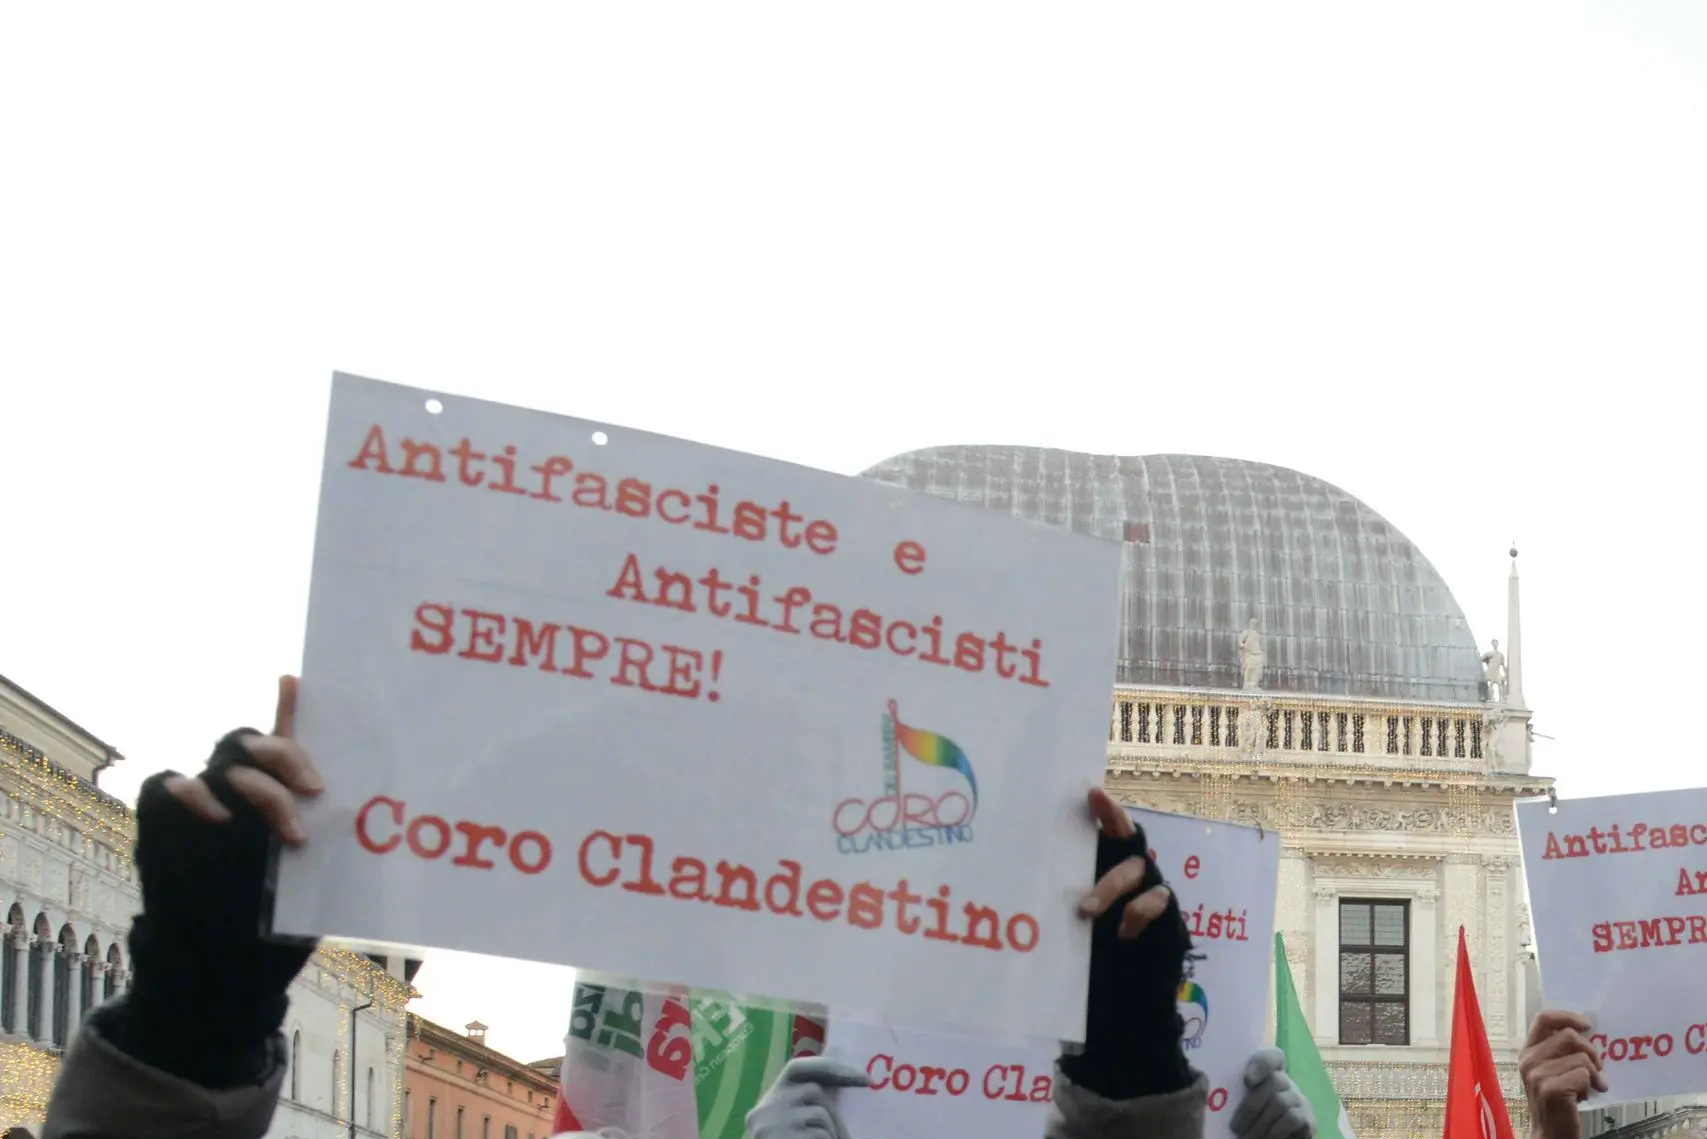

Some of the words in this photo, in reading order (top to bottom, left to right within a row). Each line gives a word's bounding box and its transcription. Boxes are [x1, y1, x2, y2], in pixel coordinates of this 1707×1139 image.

[350, 425, 838, 554] Antifasciste
[895, 541, 926, 574] e
[411, 604, 722, 702] SEMPRE!
[608, 554, 1049, 686] Antifascisti
[833, 792, 970, 837] CORO
[356, 796, 553, 874] Coro
[579, 832, 1039, 953] Clandestino
[1184, 856, 1200, 880] e
[867, 1054, 969, 1096] Coro
